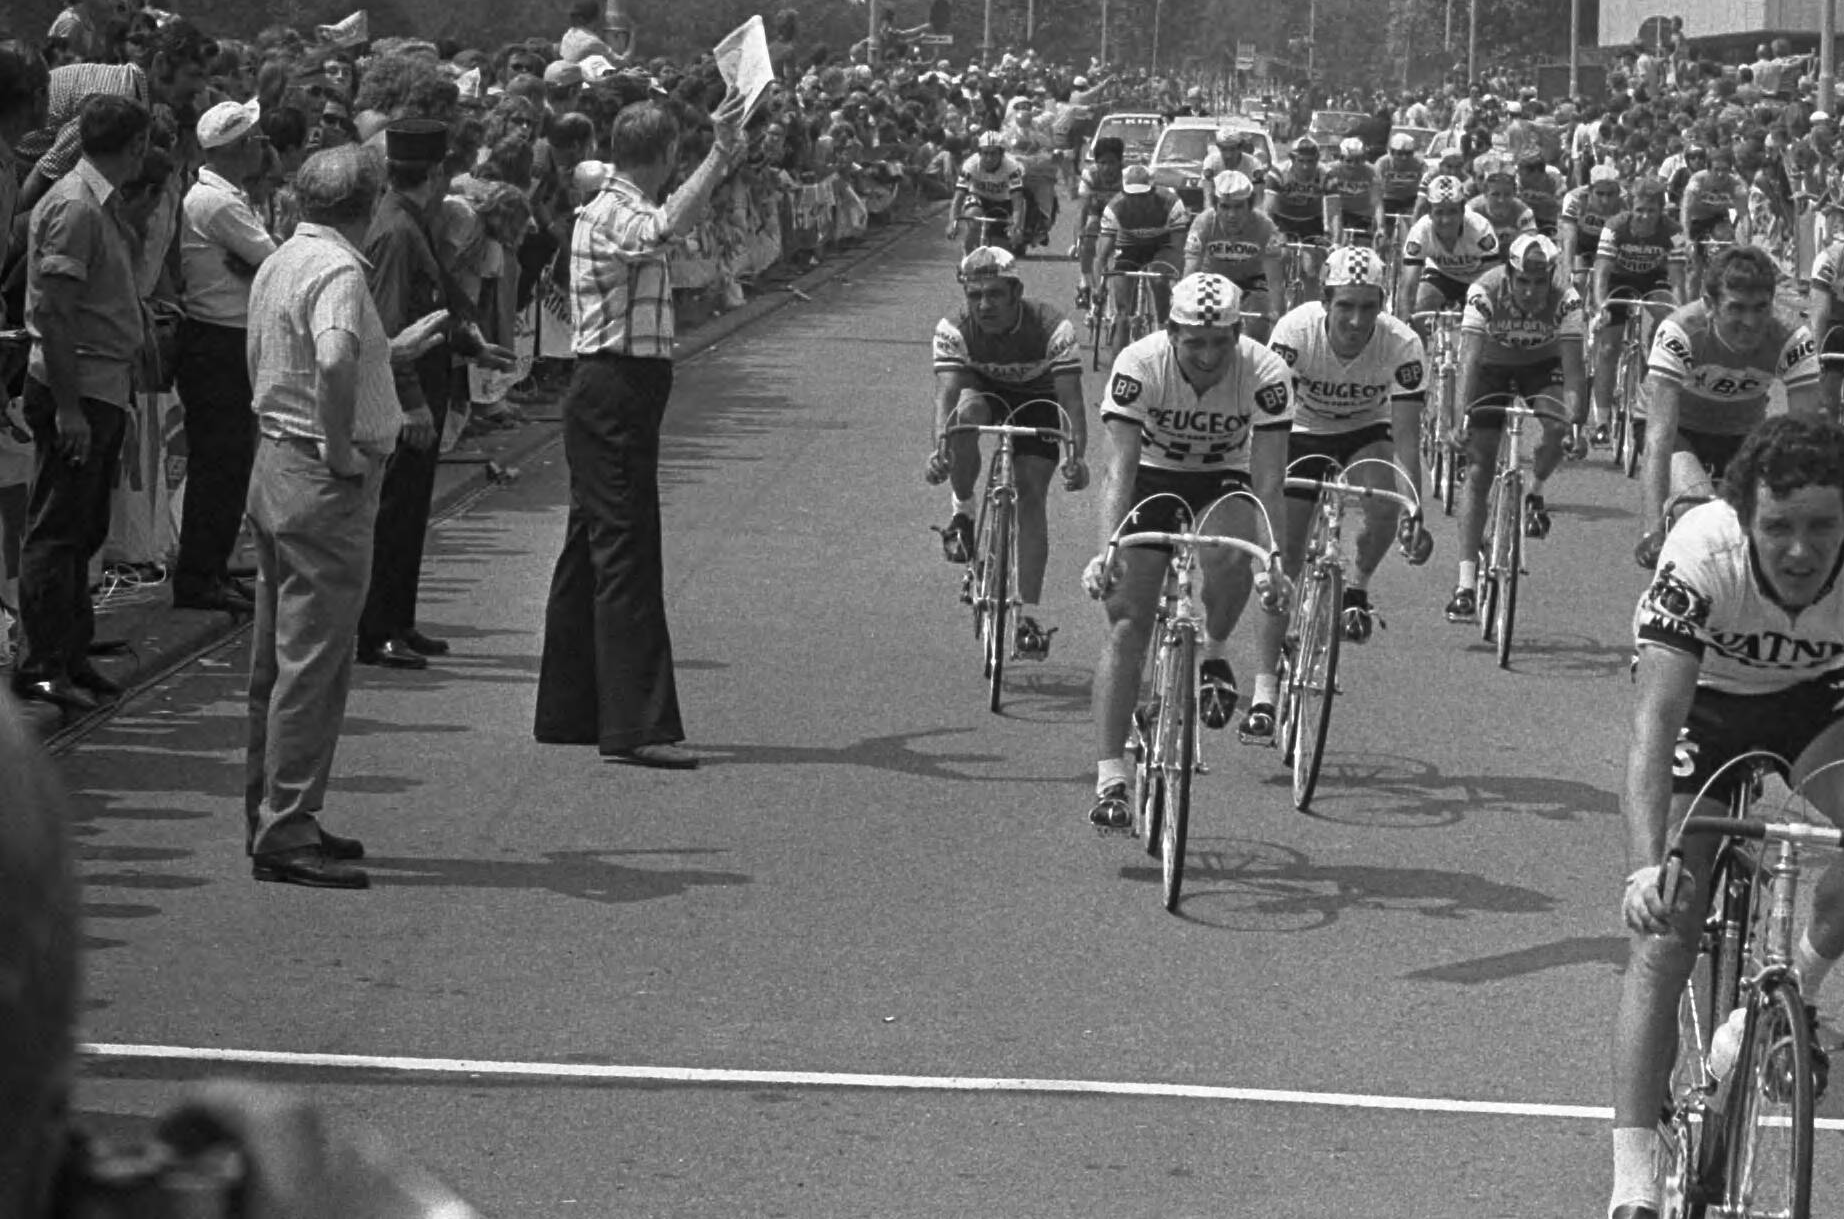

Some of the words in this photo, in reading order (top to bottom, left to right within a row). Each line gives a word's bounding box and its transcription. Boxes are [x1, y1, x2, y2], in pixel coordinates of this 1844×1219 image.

[1787, 339, 1815, 368] BIC
[1401, 365, 1421, 382] BP
[1114, 379, 1139, 398] BP
[1263, 385, 1286, 409] BP
